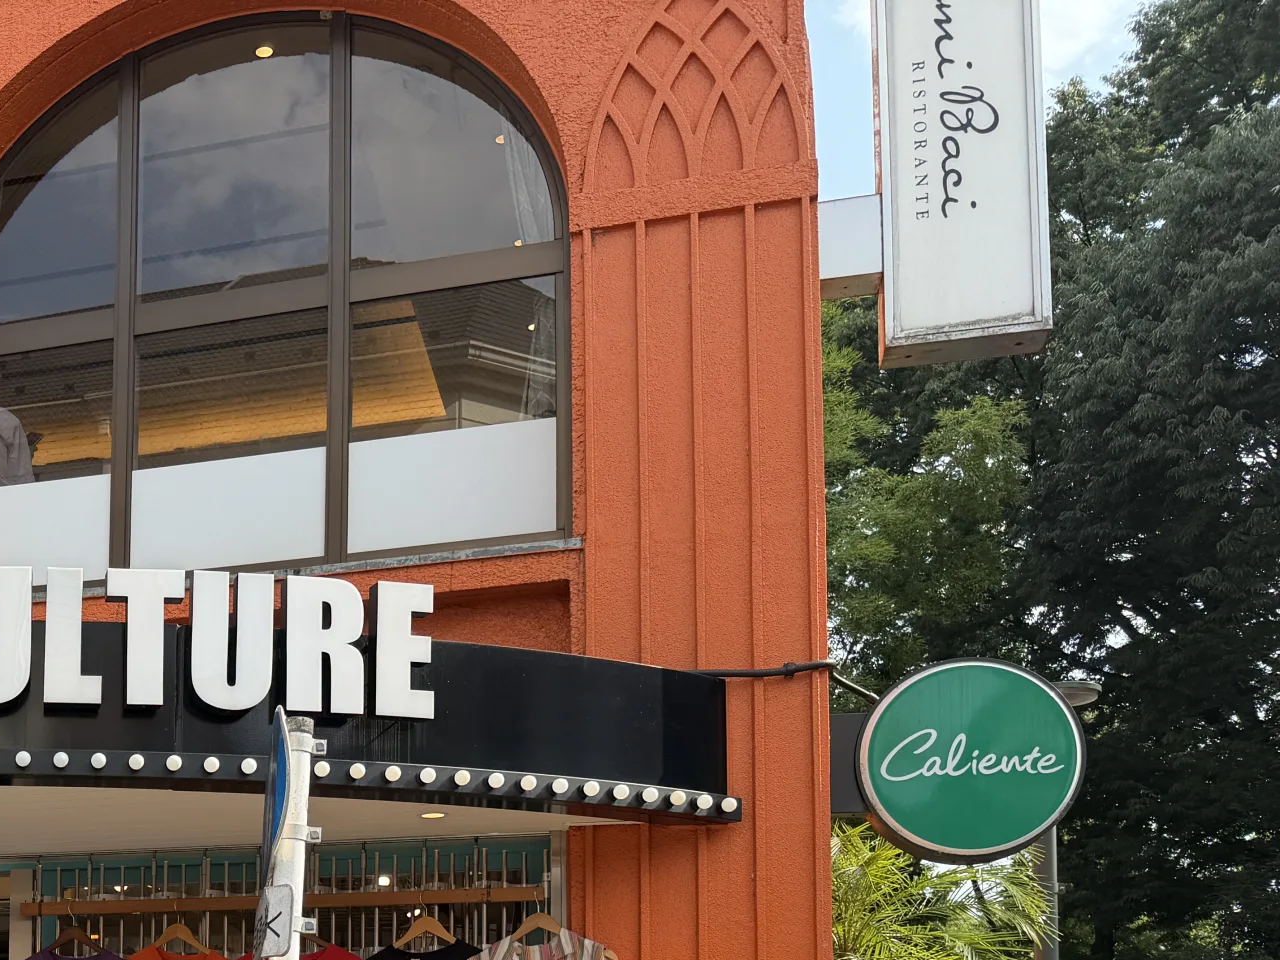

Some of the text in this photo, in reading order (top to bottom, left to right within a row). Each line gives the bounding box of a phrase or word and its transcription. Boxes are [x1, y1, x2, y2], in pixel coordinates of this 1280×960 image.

[912, 60, 930, 221] RISTORANTE
[939, 86, 1000, 219] Baci
[880, 728, 1065, 782] Caliente
